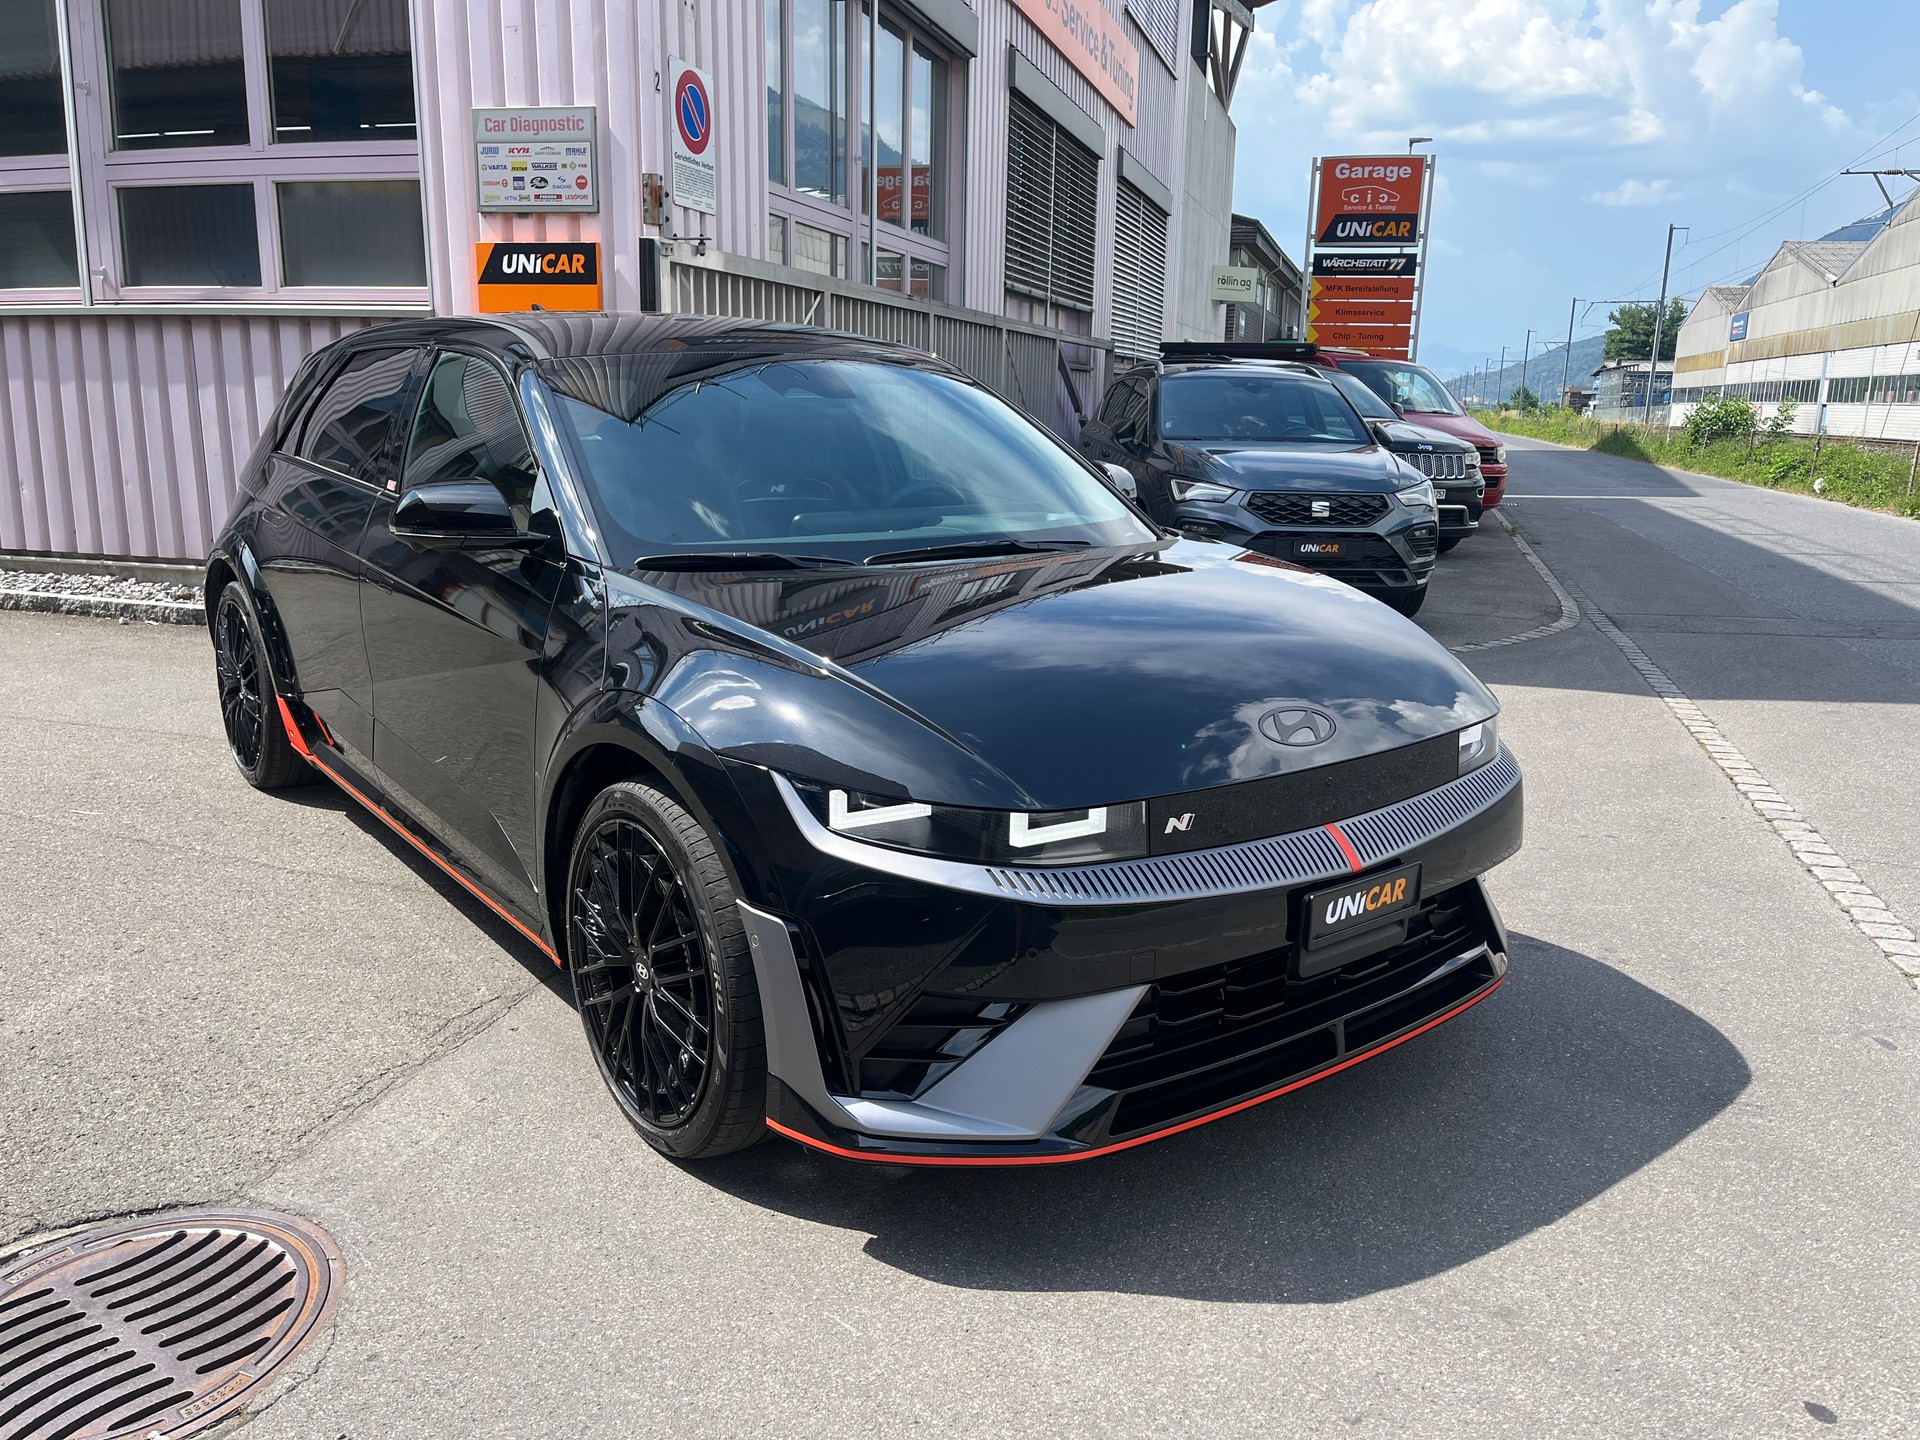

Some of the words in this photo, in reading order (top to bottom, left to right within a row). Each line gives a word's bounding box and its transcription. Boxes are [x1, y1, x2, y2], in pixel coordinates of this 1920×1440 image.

[1061, 0, 1099, 62] Service
[1101, 32, 1108, 74] &
[1109, 39, 1135, 111] Tuning
[655, 72, 661, 92] 2
[485, 117, 506, 132] Car
[510, 115, 584, 135] Diagnostic
[1335, 163, 1412, 182] Garage
[1388, 258, 1407, 270] 77
[1240, 279, 1251, 290] ag
[1345, 285, 1399, 293] Bereitstellung
[1333, 332, 1351, 340] Chip
[1358, 333, 1384, 341] Tuning
[1417, 443, 1433, 451] Jeep
